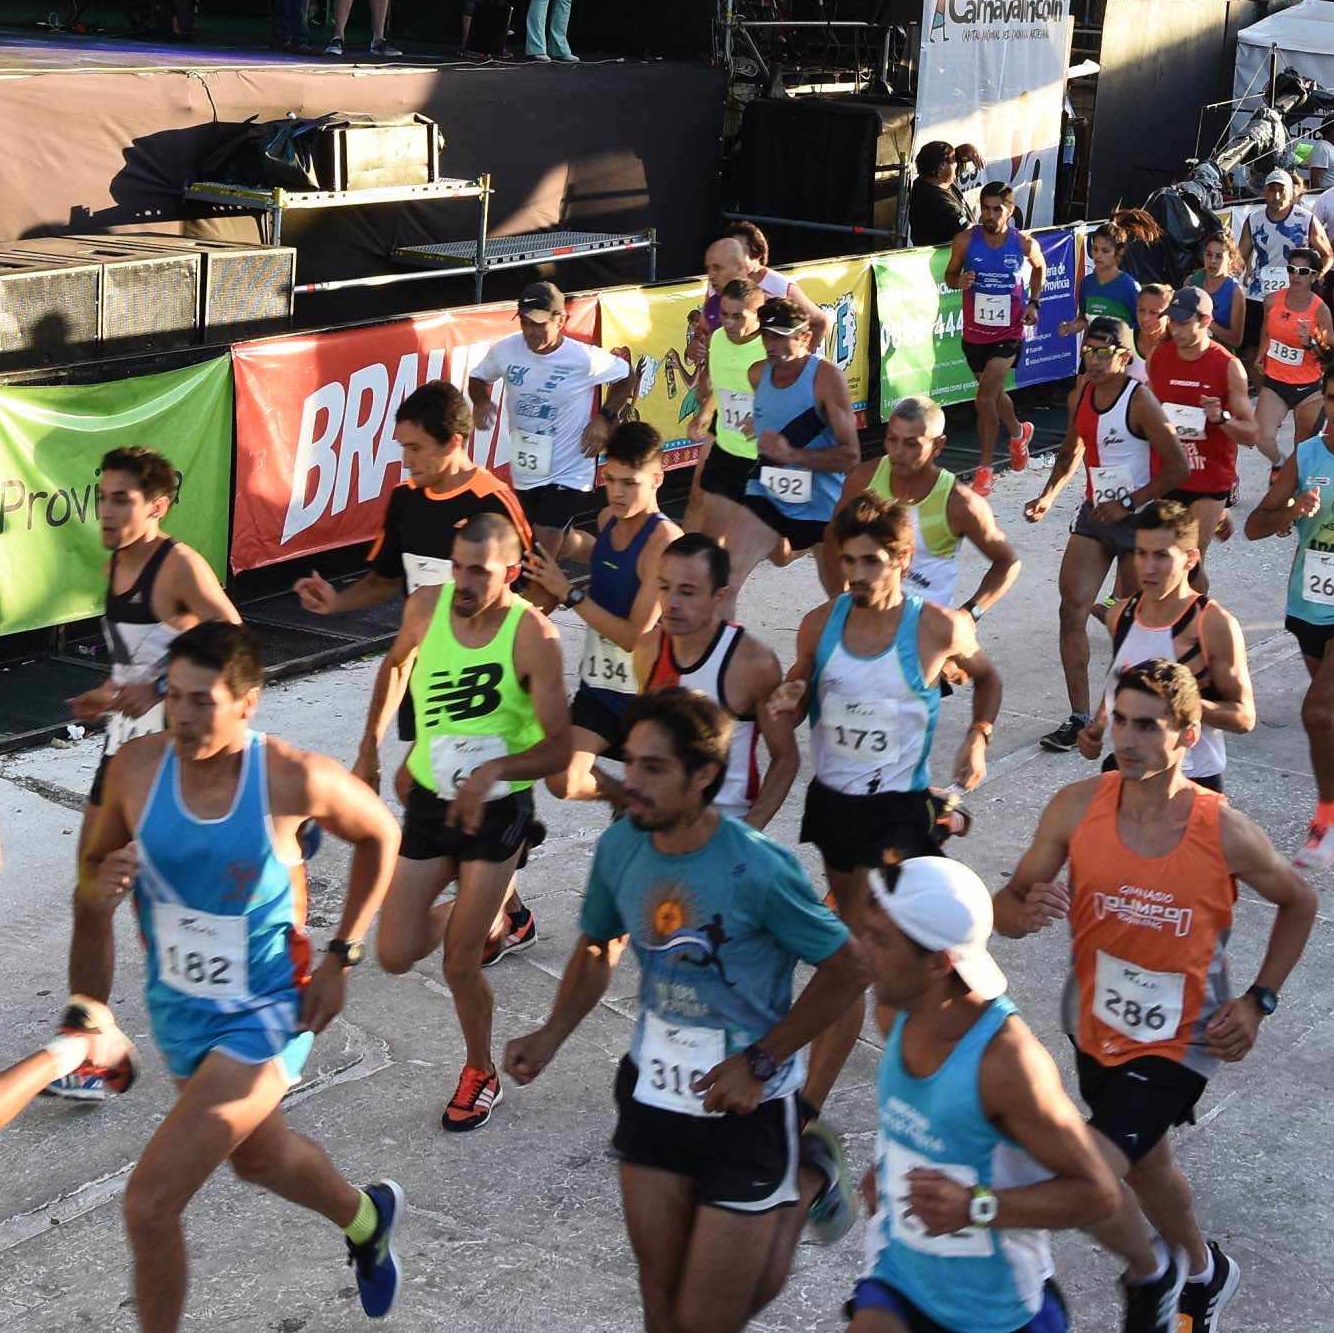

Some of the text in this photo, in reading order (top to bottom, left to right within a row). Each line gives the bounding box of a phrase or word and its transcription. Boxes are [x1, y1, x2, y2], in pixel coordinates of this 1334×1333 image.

[1263, 279, 1286, 290] 222
[979, 307, 1006, 321] 114
[1273, 344, 1299, 361] 183
[517, 450, 538, 471] 53
[766, 477, 803, 497] 192
[587, 656, 628, 683] 134
[835, 725, 889, 753] 173
[167, 945, 232, 985] 182
[1104, 988, 1166, 1032] 286
